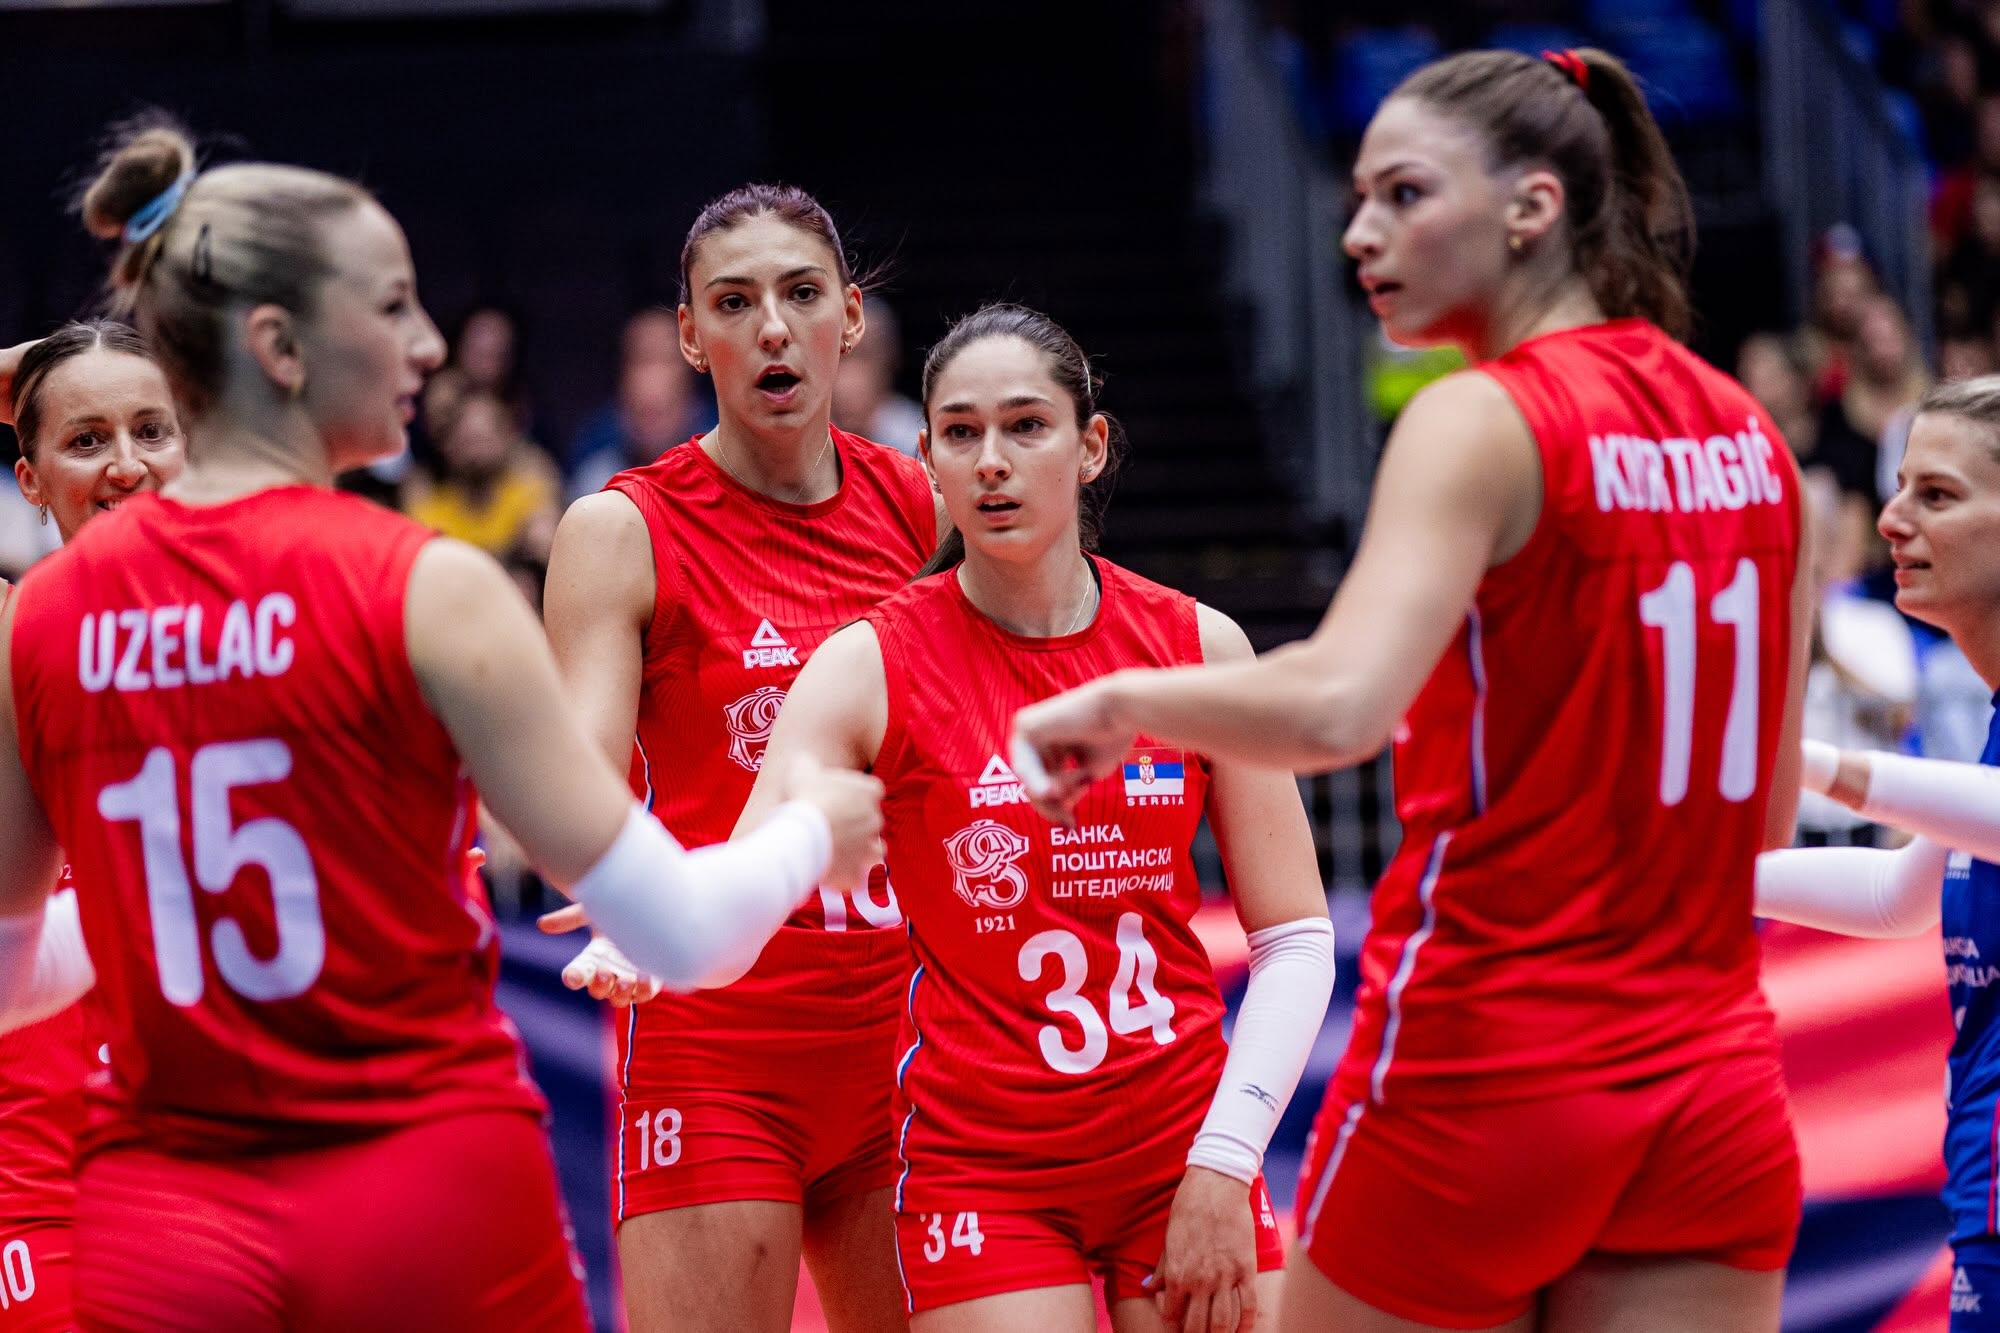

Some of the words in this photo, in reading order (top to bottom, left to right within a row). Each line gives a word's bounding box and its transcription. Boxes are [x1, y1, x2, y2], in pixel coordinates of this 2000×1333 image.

[78, 592, 296, 692] UZELAC
[743, 647, 801, 669] PEAK
[1639, 557, 1760, 807] 11
[969, 782, 1030, 808] PEAK
[1127, 796, 1184, 806] SERBIA
[1050, 824, 1125, 846] БАНКА
[97, 737, 326, 1007] 15
[1052, 847, 1171, 872] ПОШТАНСКА
[974, 914, 1016, 934] 1921
[1018, 911, 1177, 1074] 34
[635, 1107, 682, 1171] 18
[919, 1211, 985, 1263] 34
